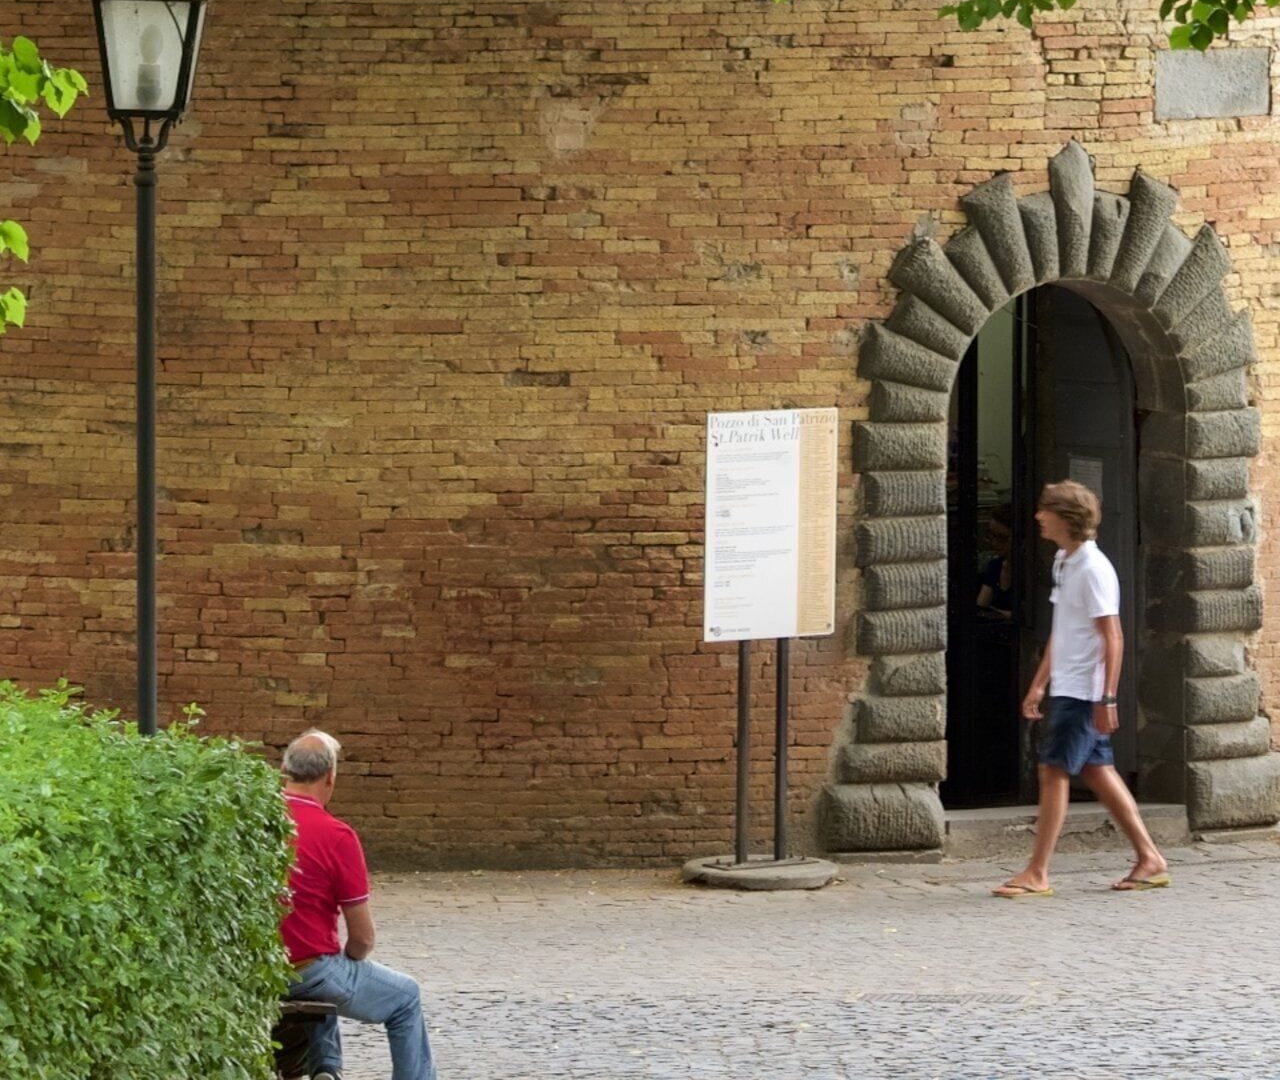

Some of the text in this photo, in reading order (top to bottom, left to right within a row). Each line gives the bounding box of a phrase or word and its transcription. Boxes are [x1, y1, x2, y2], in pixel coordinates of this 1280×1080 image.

[710, 410, 836, 429] Pozzo di San Patrizio
[771, 426, 800, 440] Well
